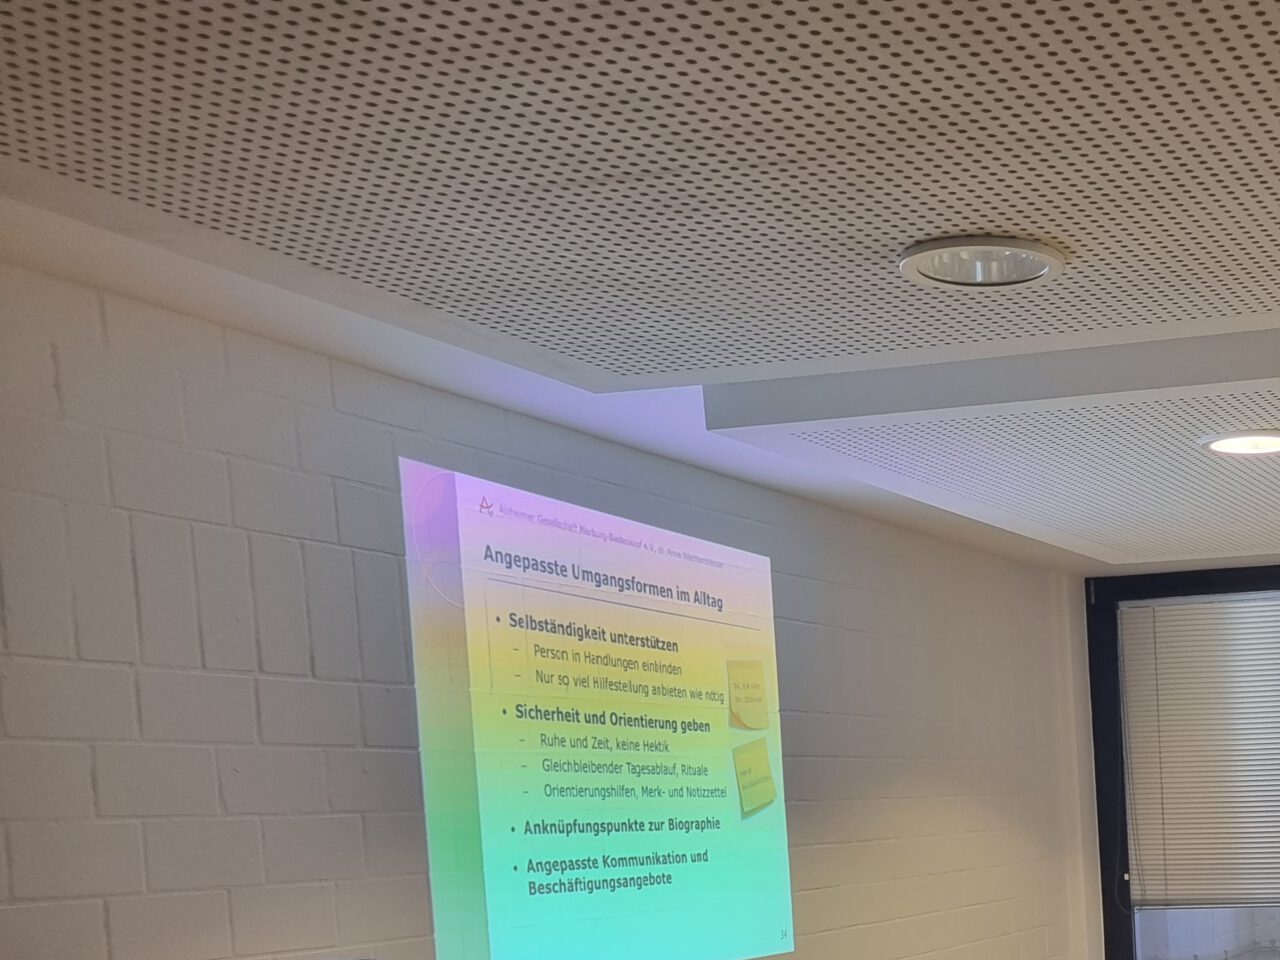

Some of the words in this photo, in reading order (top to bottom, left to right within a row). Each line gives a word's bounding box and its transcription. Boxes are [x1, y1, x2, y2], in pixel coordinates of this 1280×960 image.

[484, 544, 568, 577] Angepasste
[571, 563, 673, 599] Umgangsformen
[676, 585, 690, 602] im
[693, 590, 723, 612] Alltag
[508, 612, 607, 641] Selbständigkeit
[610, 631, 679, 652] unterstützen
[534, 643, 569, 661] Person
[572, 649, 581, 662] in
[584, 651, 640, 671] Handlungen
[642, 658, 683, 676] einbinden
[536, 669, 555, 684] Nur
[558, 674, 570, 686] so
[573, 675, 590, 689] viel
[593, 676, 649, 698] Hilfestellung
[652, 683, 687, 700] anbieten
[689, 687, 703, 700] wie
[705, 688, 725, 705] nötig
[515, 704, 581, 724] Sicherheit
[584, 711, 606, 725] und
[609, 712, 678, 733] Orientierung
[681, 718, 711, 734] geben
[540, 733, 567, 747] Ruhe
[570, 736, 588, 749] und
[591, 736, 613, 752] Zeit,
[616, 737, 640, 752] keine
[642, 739, 670, 753] Hektik
[542, 758, 623, 774] Gleichbleibender
[626, 762, 679, 778] Tagesablauf,
[681, 763, 709, 776] Rituale
[543, 783, 638, 801] Orientierungshilfen,
[641, 785, 666, 798] Merk-
[668, 785, 684, 798] und
[686, 785, 727, 799] Notizzettel
[524, 818, 646, 836] Anknüpfungspunkte
[648, 820, 665, 832] zur
[668, 816, 721, 834] Biographie
[527, 856, 599, 876] Angepasste
[602, 850, 688, 869] Kommunikation
[690, 849, 709, 863] und
[528, 872, 673, 896] Beschäftigungsangebote
